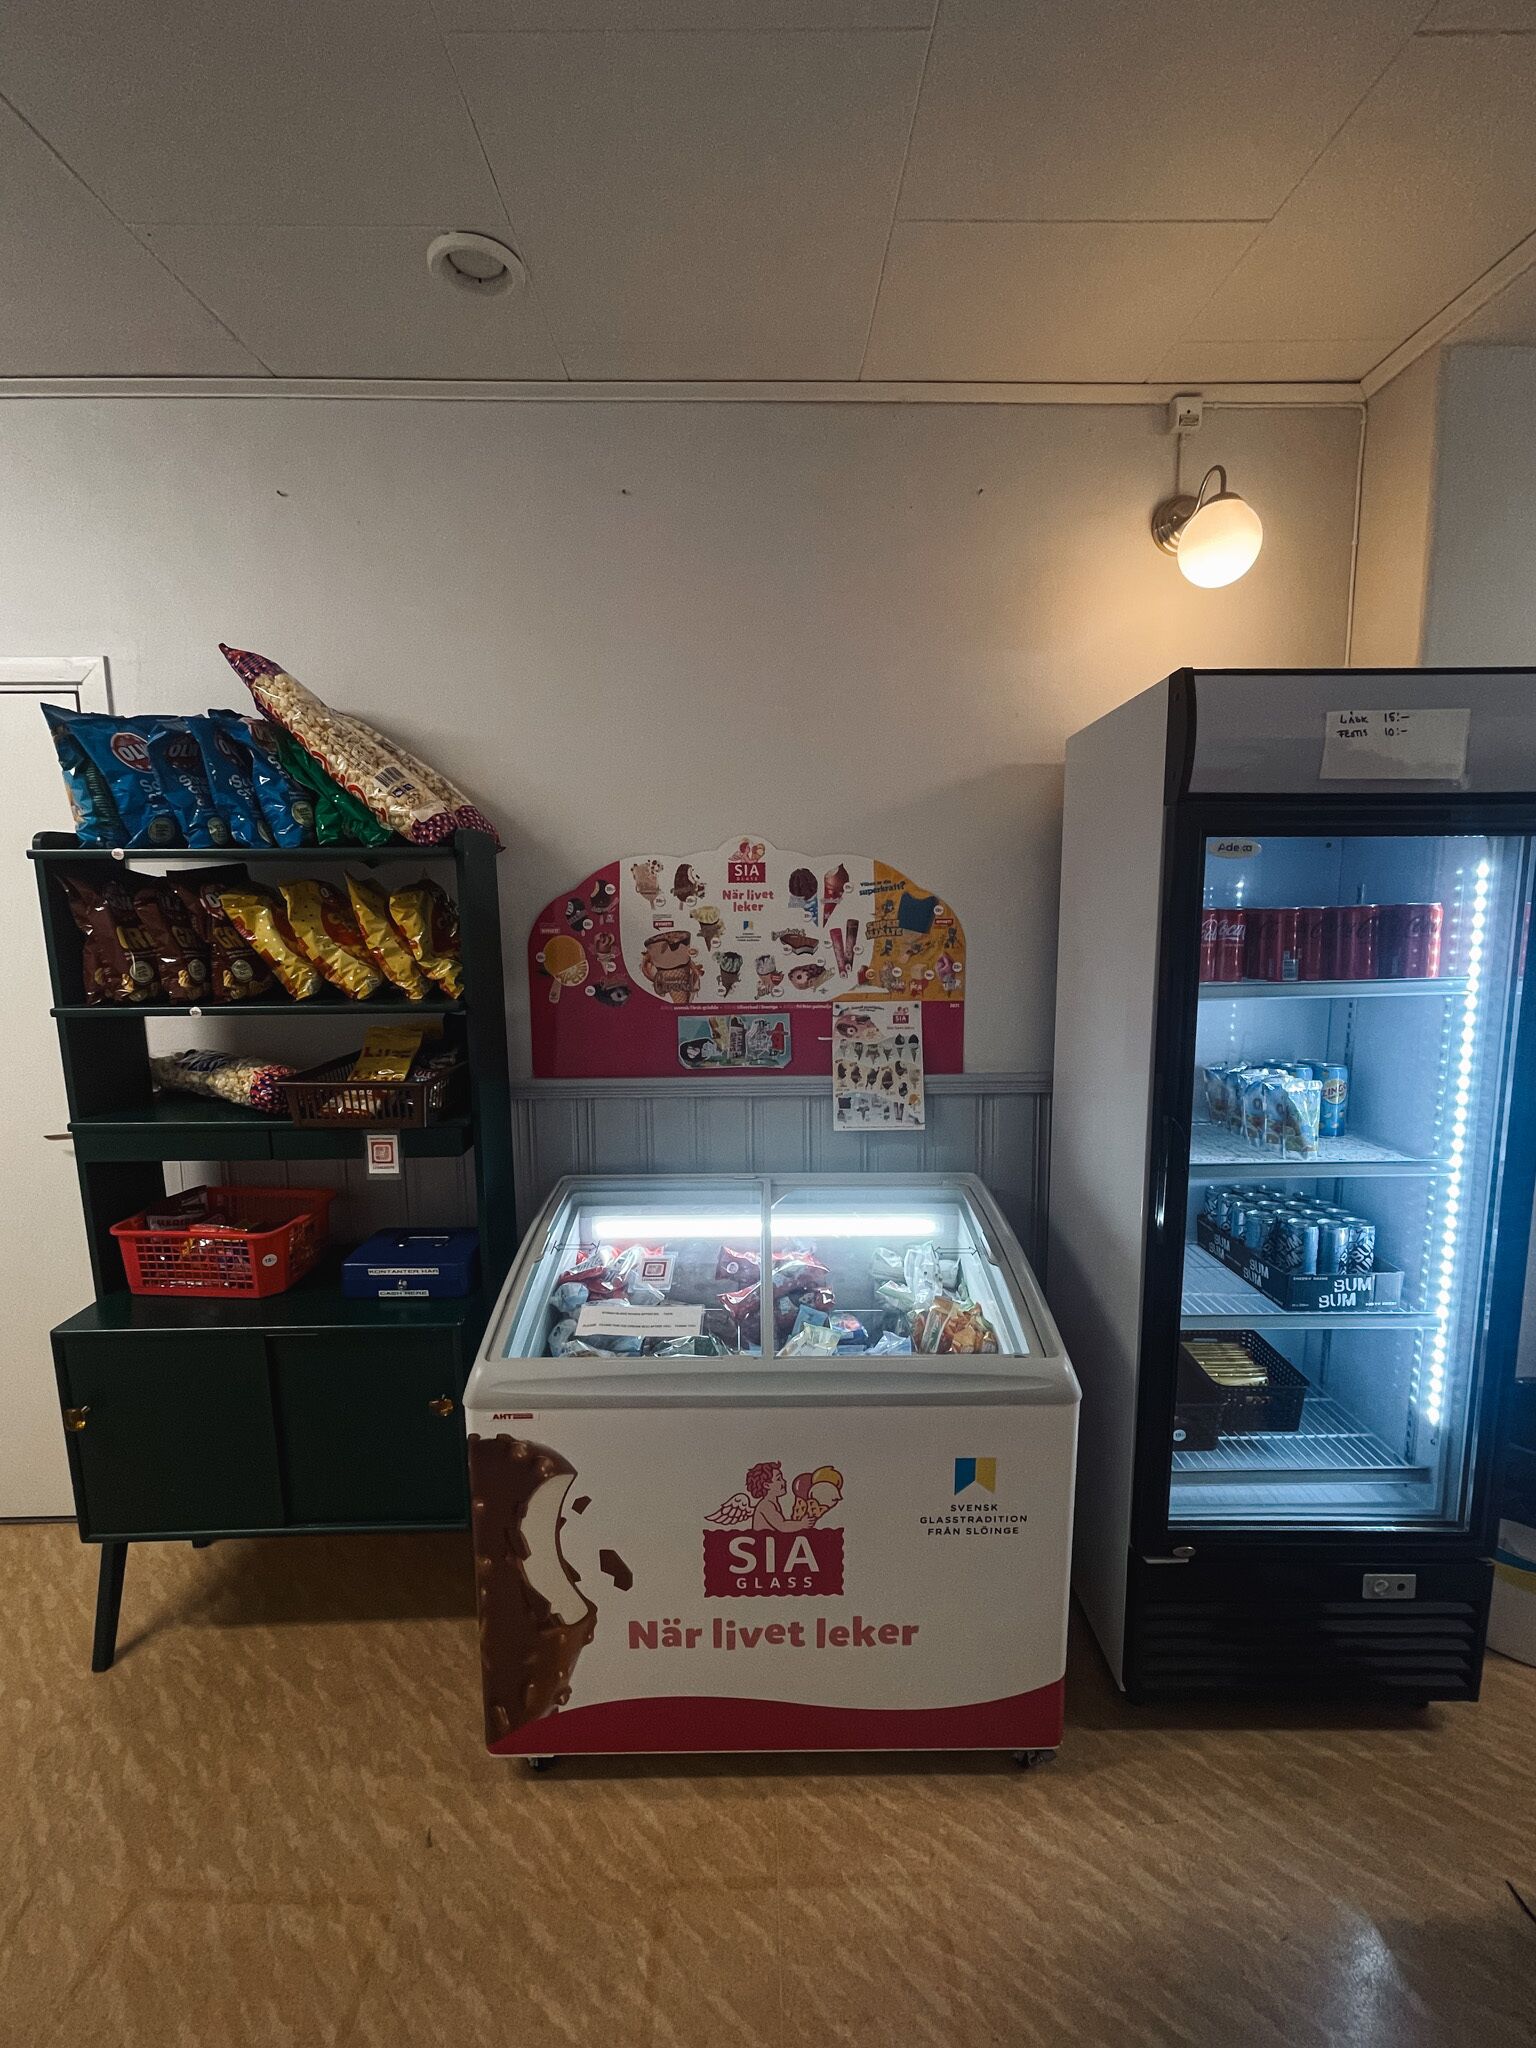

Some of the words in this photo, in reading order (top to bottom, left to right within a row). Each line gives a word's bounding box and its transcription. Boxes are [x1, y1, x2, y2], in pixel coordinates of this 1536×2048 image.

[734, 864, 760, 876] SIA
[722, 889, 744, 900] När
[747, 889, 775, 901] livet
[733, 901, 764, 912] leker
[1334, 1276, 1372, 1293] BUM
[1318, 1292, 1356, 1308] BUM
[950, 1504, 998, 1512] SVENSK
[920, 1515, 1028, 1524] GLASSTRADITION
[928, 1526, 960, 1535] FRÅN
[966, 1526, 1019, 1535] SLÖINGE
[729, 1536, 820, 1574] SIA
[736, 1577, 813, 1589] GLASS
[628, 1618, 703, 1650] När
[713, 1617, 806, 1651] livet
[816, 1615, 919, 1649] leker
